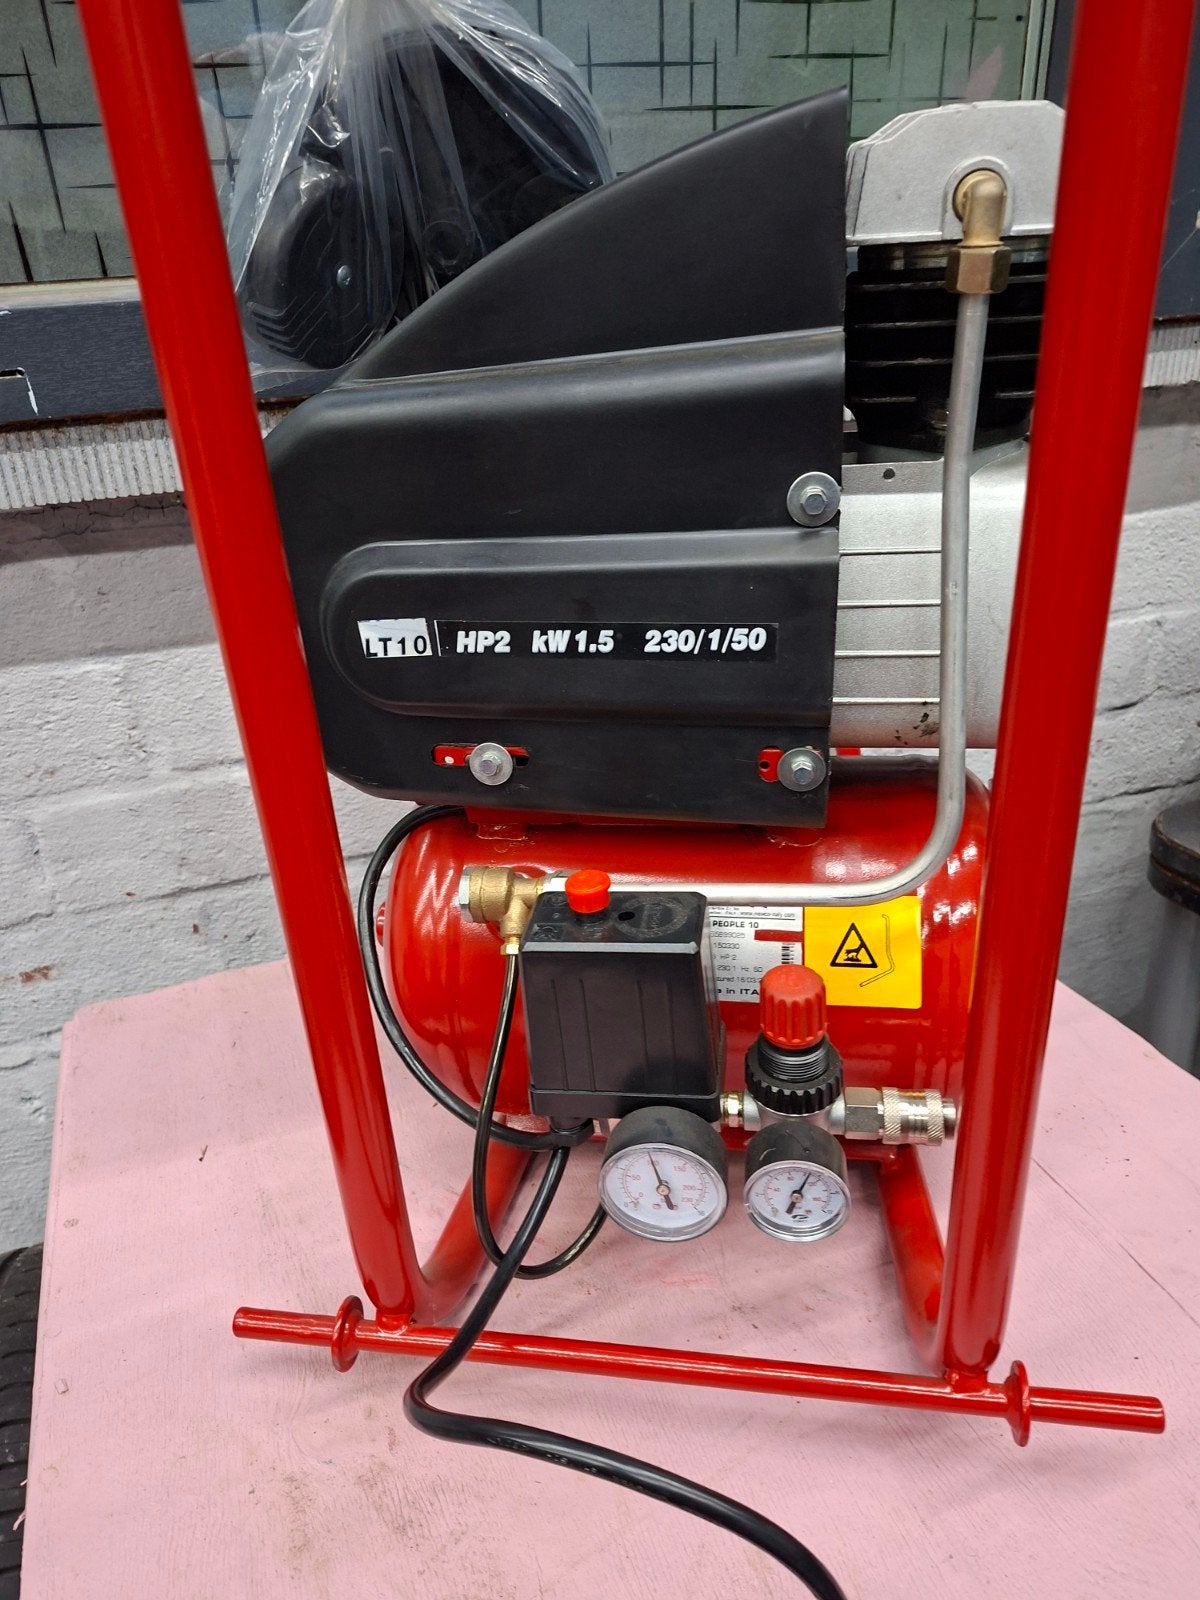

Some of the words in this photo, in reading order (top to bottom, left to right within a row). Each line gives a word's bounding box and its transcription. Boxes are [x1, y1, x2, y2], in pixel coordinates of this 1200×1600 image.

[364, 635, 428, 658] LT10
[456, 631, 511, 654] HP2
[531, 629, 570, 654] kW
[574, 630, 614, 654] 1.5
[644, 627, 767, 654] 230/1/50
[712, 920, 745, 929] PEOPLE
[739, 988, 760, 996] ITA
